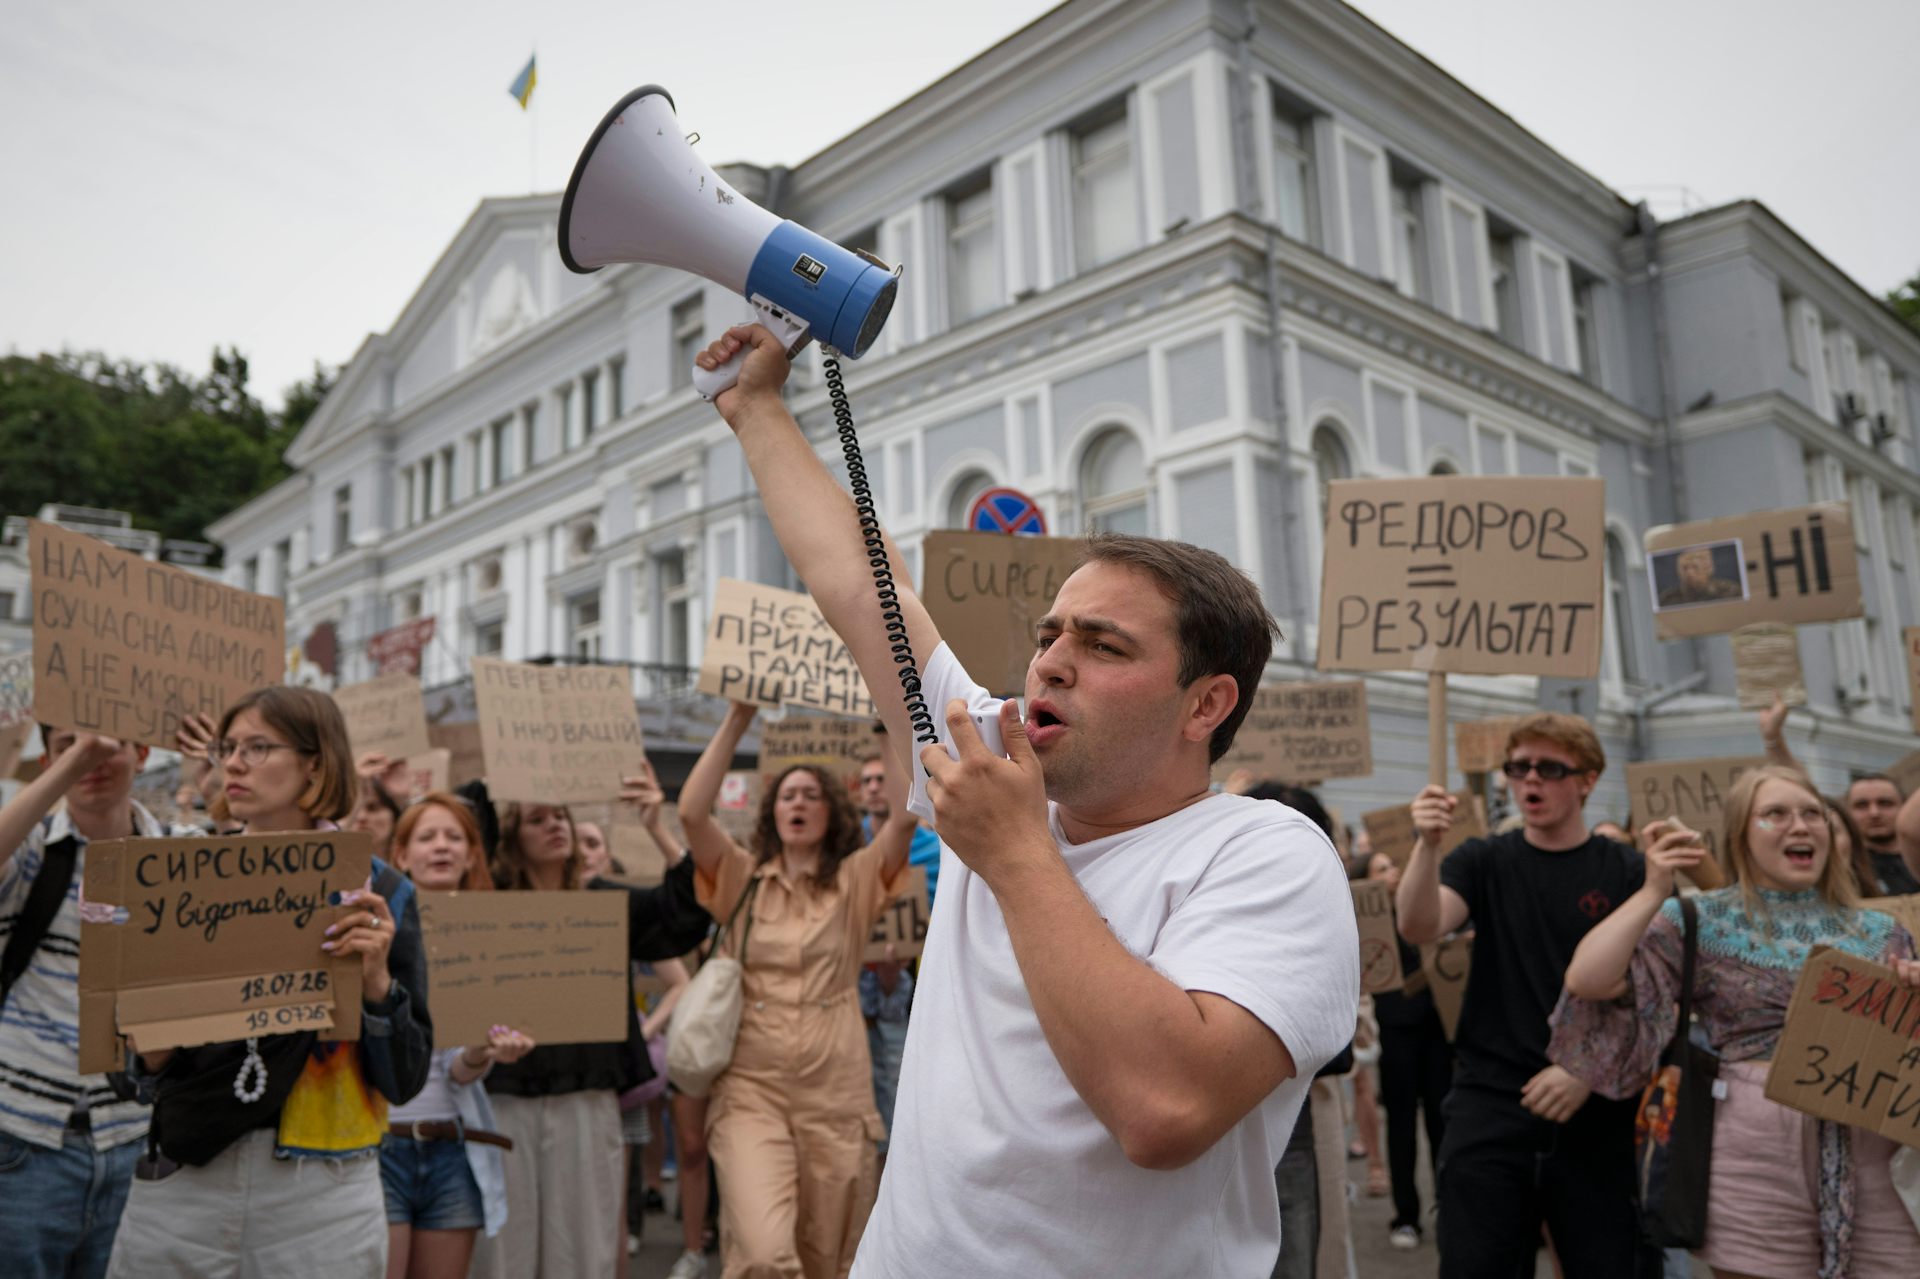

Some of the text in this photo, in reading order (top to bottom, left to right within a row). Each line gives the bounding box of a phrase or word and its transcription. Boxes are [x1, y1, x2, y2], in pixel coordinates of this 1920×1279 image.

[1340, 500, 1589, 562] ФЕДОРОВ
[43, 538, 277, 639] НАМ ПОТРІБНА
[40, 589, 178, 661] СУЧАСНА
[1335, 595, 1594, 661] РЕЗУЛЬТАТ
[46, 641, 69, 687] А
[81, 647, 122, 695] НЕ
[136, 841, 336, 888] СИРСЬКОГО
